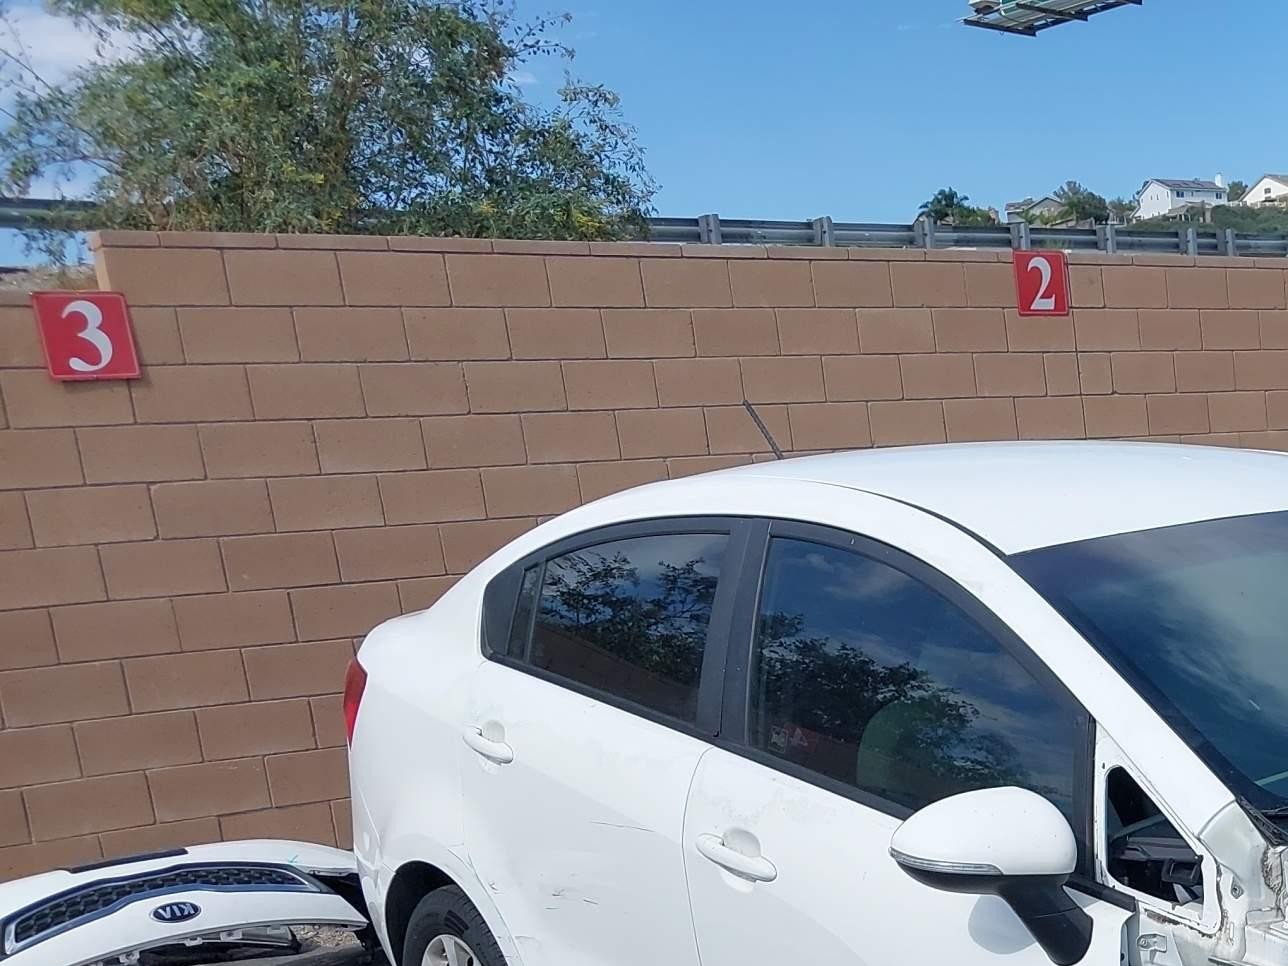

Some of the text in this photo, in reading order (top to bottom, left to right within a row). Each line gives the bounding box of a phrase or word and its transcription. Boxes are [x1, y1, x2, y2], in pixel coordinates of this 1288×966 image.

[1027, 256, 1056, 310] 2
[61, 299, 113, 372] 3
[156, 902, 197, 920] KIA
